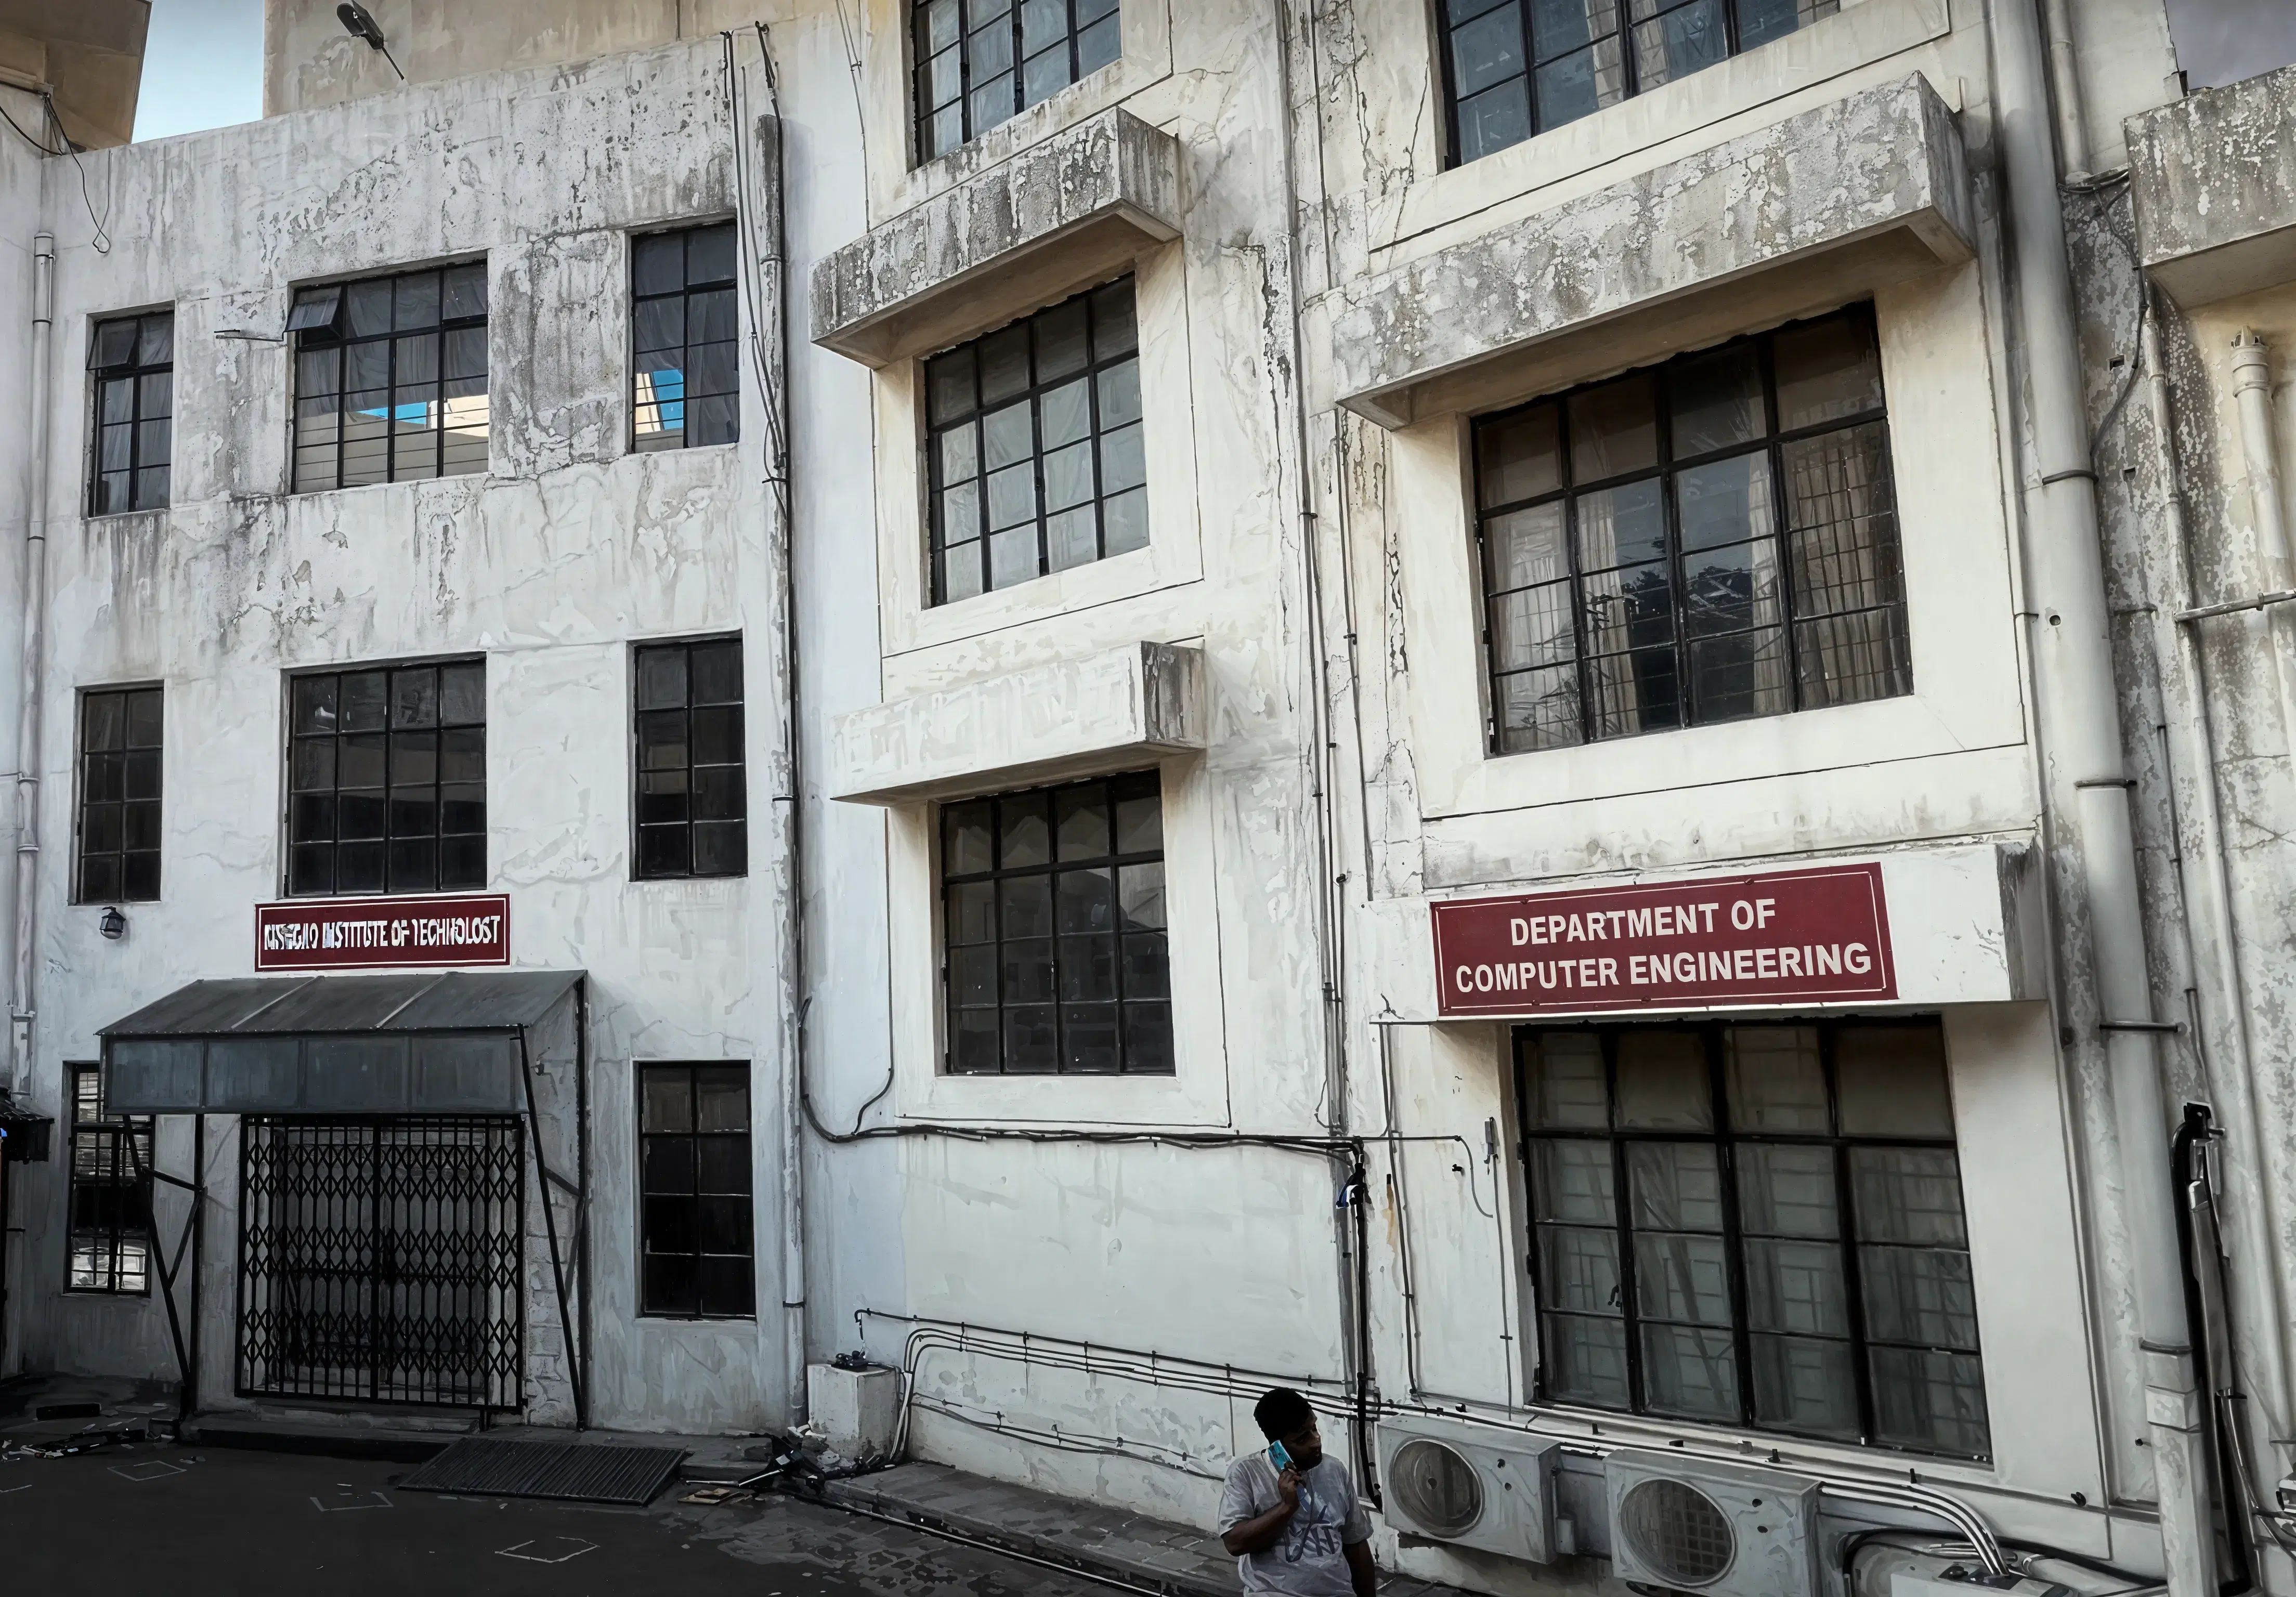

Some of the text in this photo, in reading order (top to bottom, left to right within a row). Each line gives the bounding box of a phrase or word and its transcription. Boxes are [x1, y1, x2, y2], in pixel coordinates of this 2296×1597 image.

[391, 919, 410, 947] OF
[1510, 898, 1776, 946] DEPARTMENT OF
[1455, 942, 1871, 993] COMPUTER ENGINEERING
